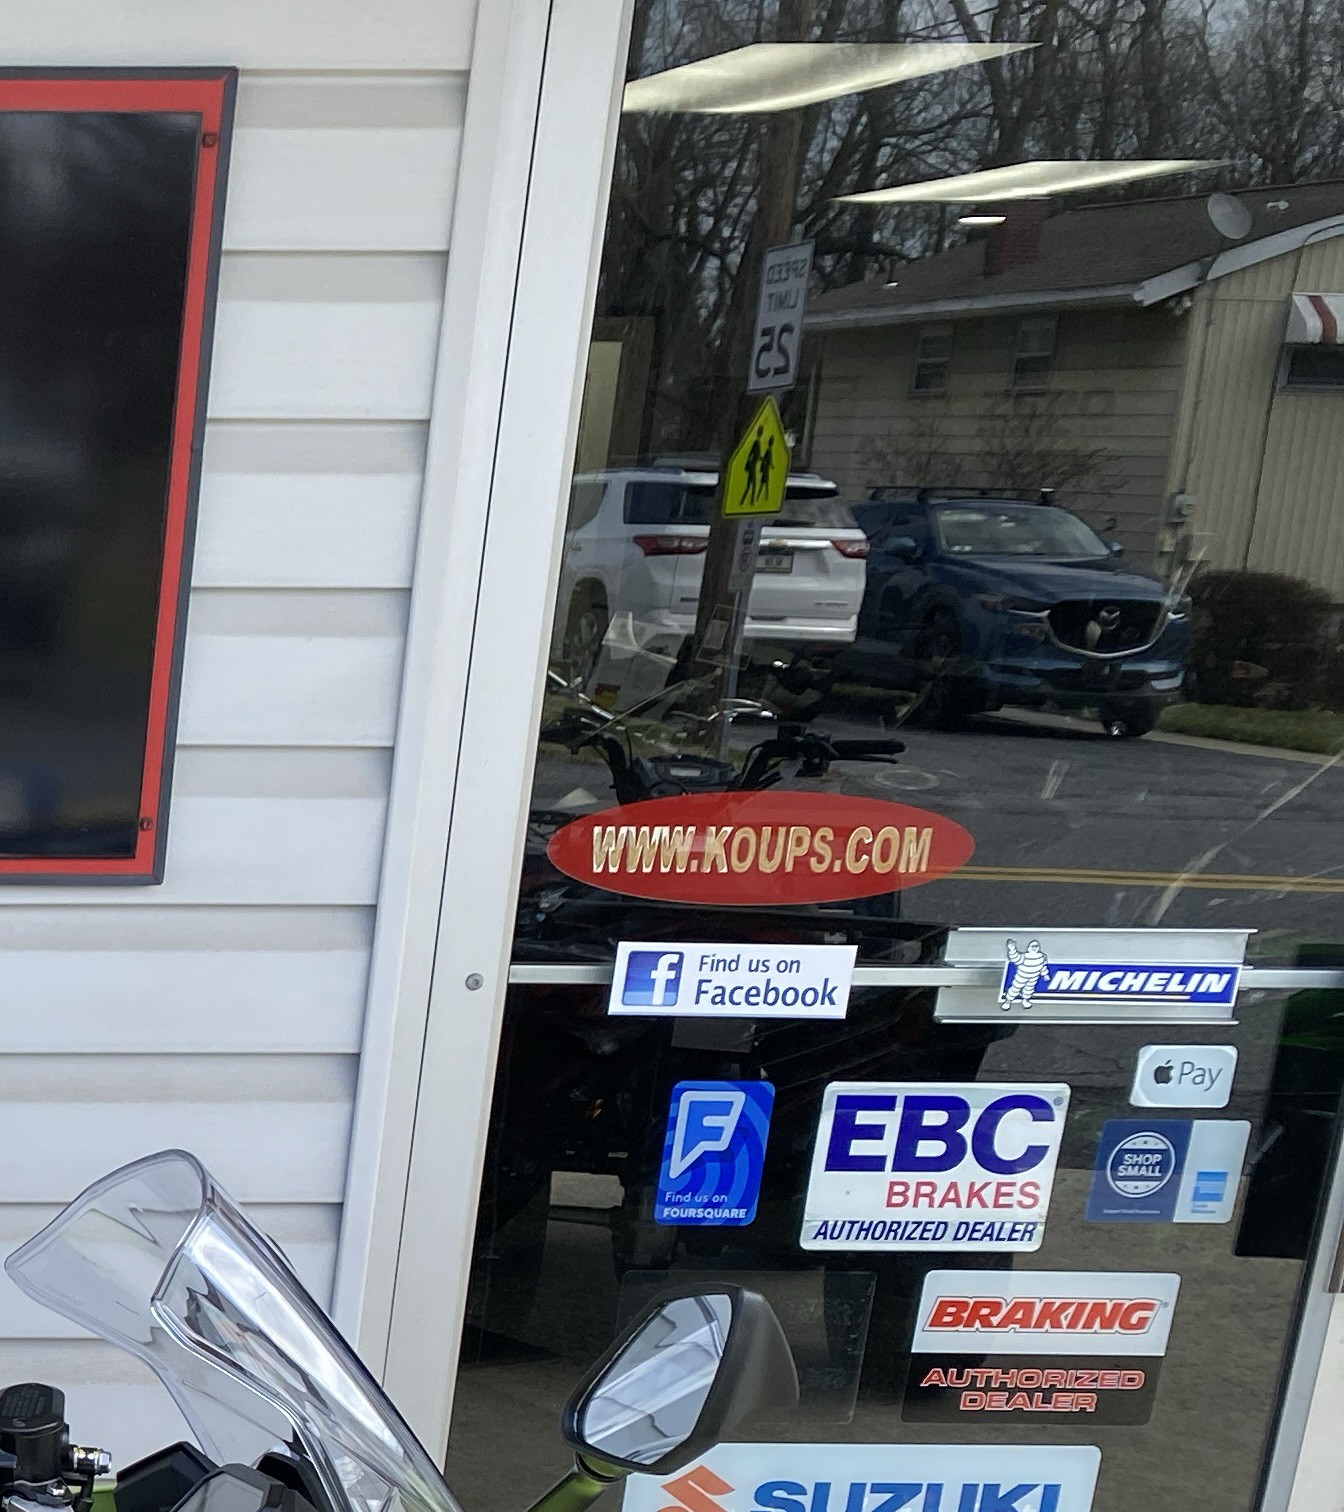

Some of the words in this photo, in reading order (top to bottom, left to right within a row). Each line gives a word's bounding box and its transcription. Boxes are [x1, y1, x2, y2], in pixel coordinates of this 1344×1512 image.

[592, 826, 934, 874] WWW.KOUPS.COM
[698, 953, 740, 974] Find
[748, 958, 771, 974] us
[775, 958, 801, 974] on
[694, 978, 839, 1007] Facebook
[1048, 970, 1232, 994] MICHELIN
[1177, 1060, 1223, 1092] Pay
[823, 1094, 1056, 1176] EBC
[1123, 1153, 1163, 1165] SHOP
[1117, 1165, 1162, 1177] SMALL
[665, 1191, 692, 1203] Find
[695, 1194, 709, 1203] us
[712, 1194, 728, 1203] on
[885, 1180, 1042, 1210] BRAKES
[663, 1207, 748, 1219] FOURSQUARE
[812, 1220, 949, 1242] AUTHORIZED
[952, 1220, 1037, 1243] DEALER
[924, 1297, 1161, 1334] BRAKING
[920, 1367, 1146, 1390] AUTHORIZED
[960, 1391, 1098, 1413] DEALER
